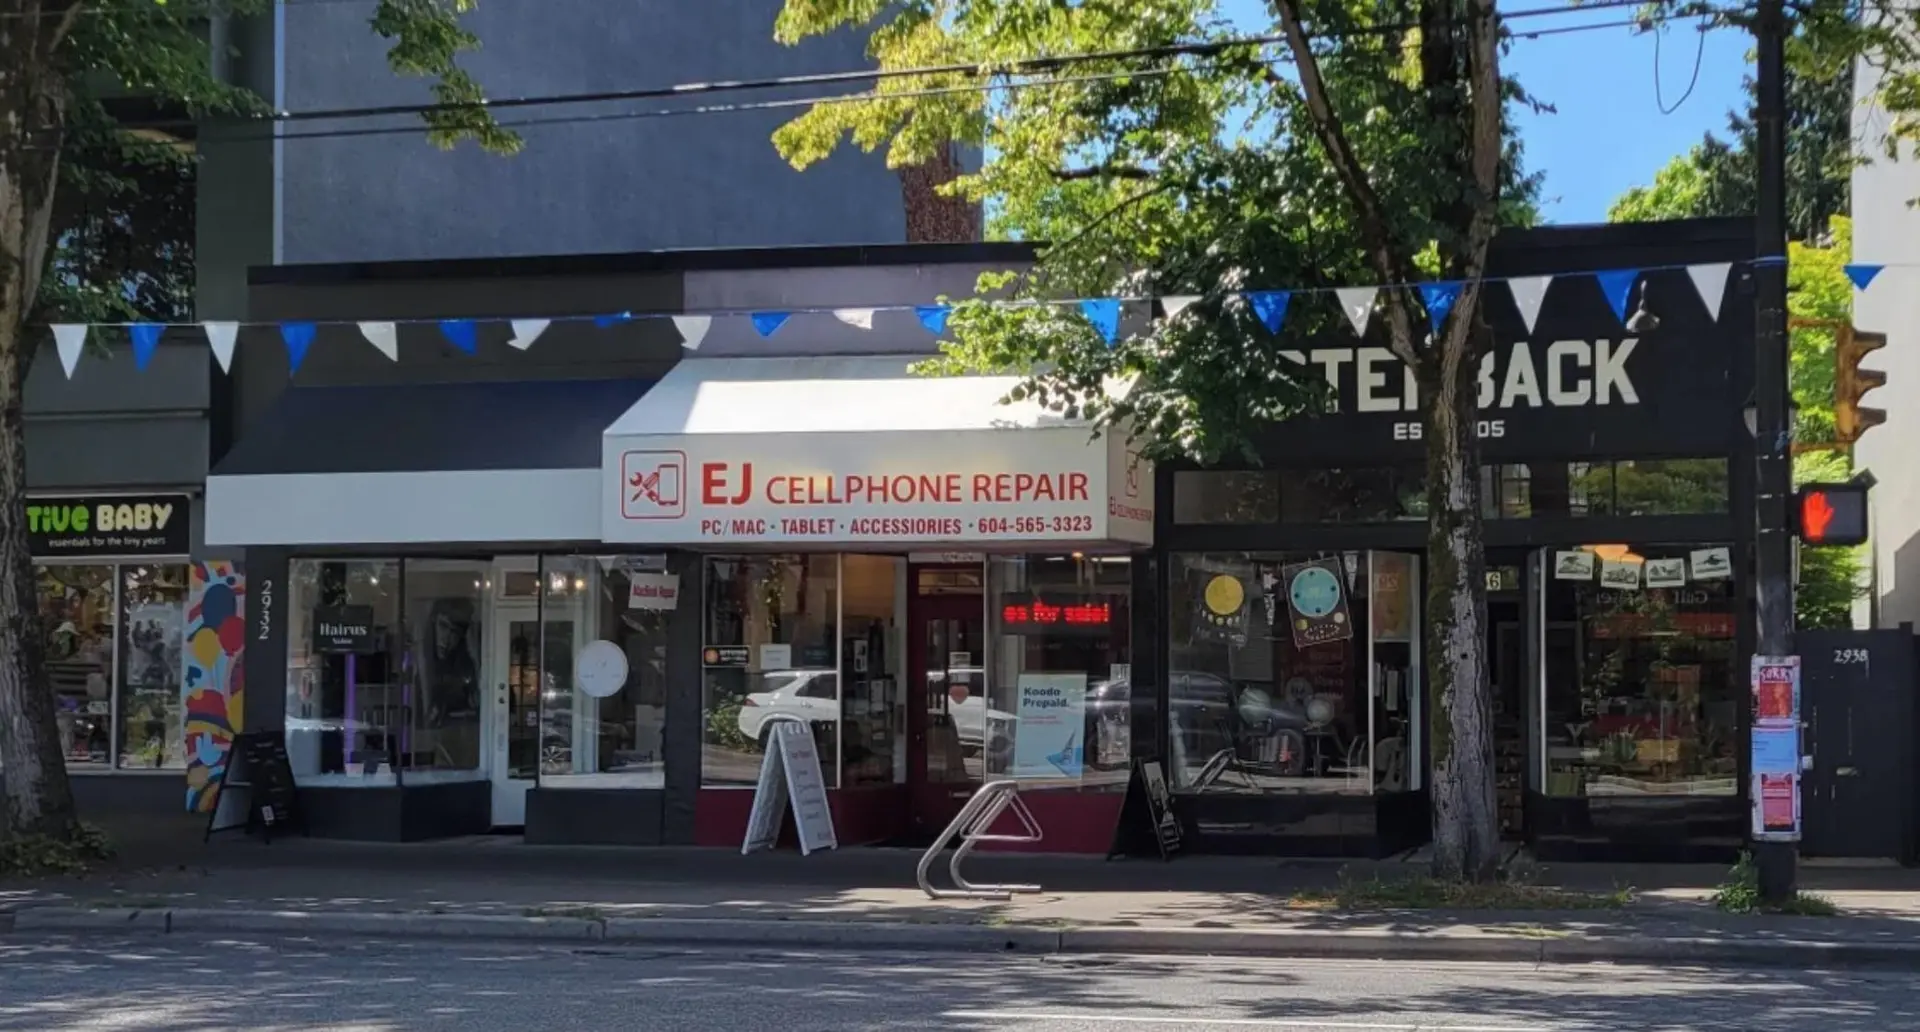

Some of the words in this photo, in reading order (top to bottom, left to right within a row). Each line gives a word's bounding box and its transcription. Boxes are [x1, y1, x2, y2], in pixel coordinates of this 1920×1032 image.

[701, 461, 754, 507] EJ
[765, 473, 963, 505] CELLPHONE
[973, 470, 1089, 503] REPAIR
[96, 503, 173, 532] BABY
[780, 517, 836, 535] TABLET
[849, 516, 962, 535] ACCESSIORIES
[977, 515, 1093, 533] 604-565-3323
[48, 537, 91, 547] essentials
[92, 537, 105, 546] for
[107, 537, 122, 546] the
[123, 537, 141, 547] tiny
[142, 536, 166, 547] years
[259, 580, 273, 640] 2932
[320, 622, 368, 637] Hairus
[1834, 649, 1869, 664] 2938
[1023, 687, 1062, 697] Koodo
[1022, 698, 1070, 710] Prepaid.
